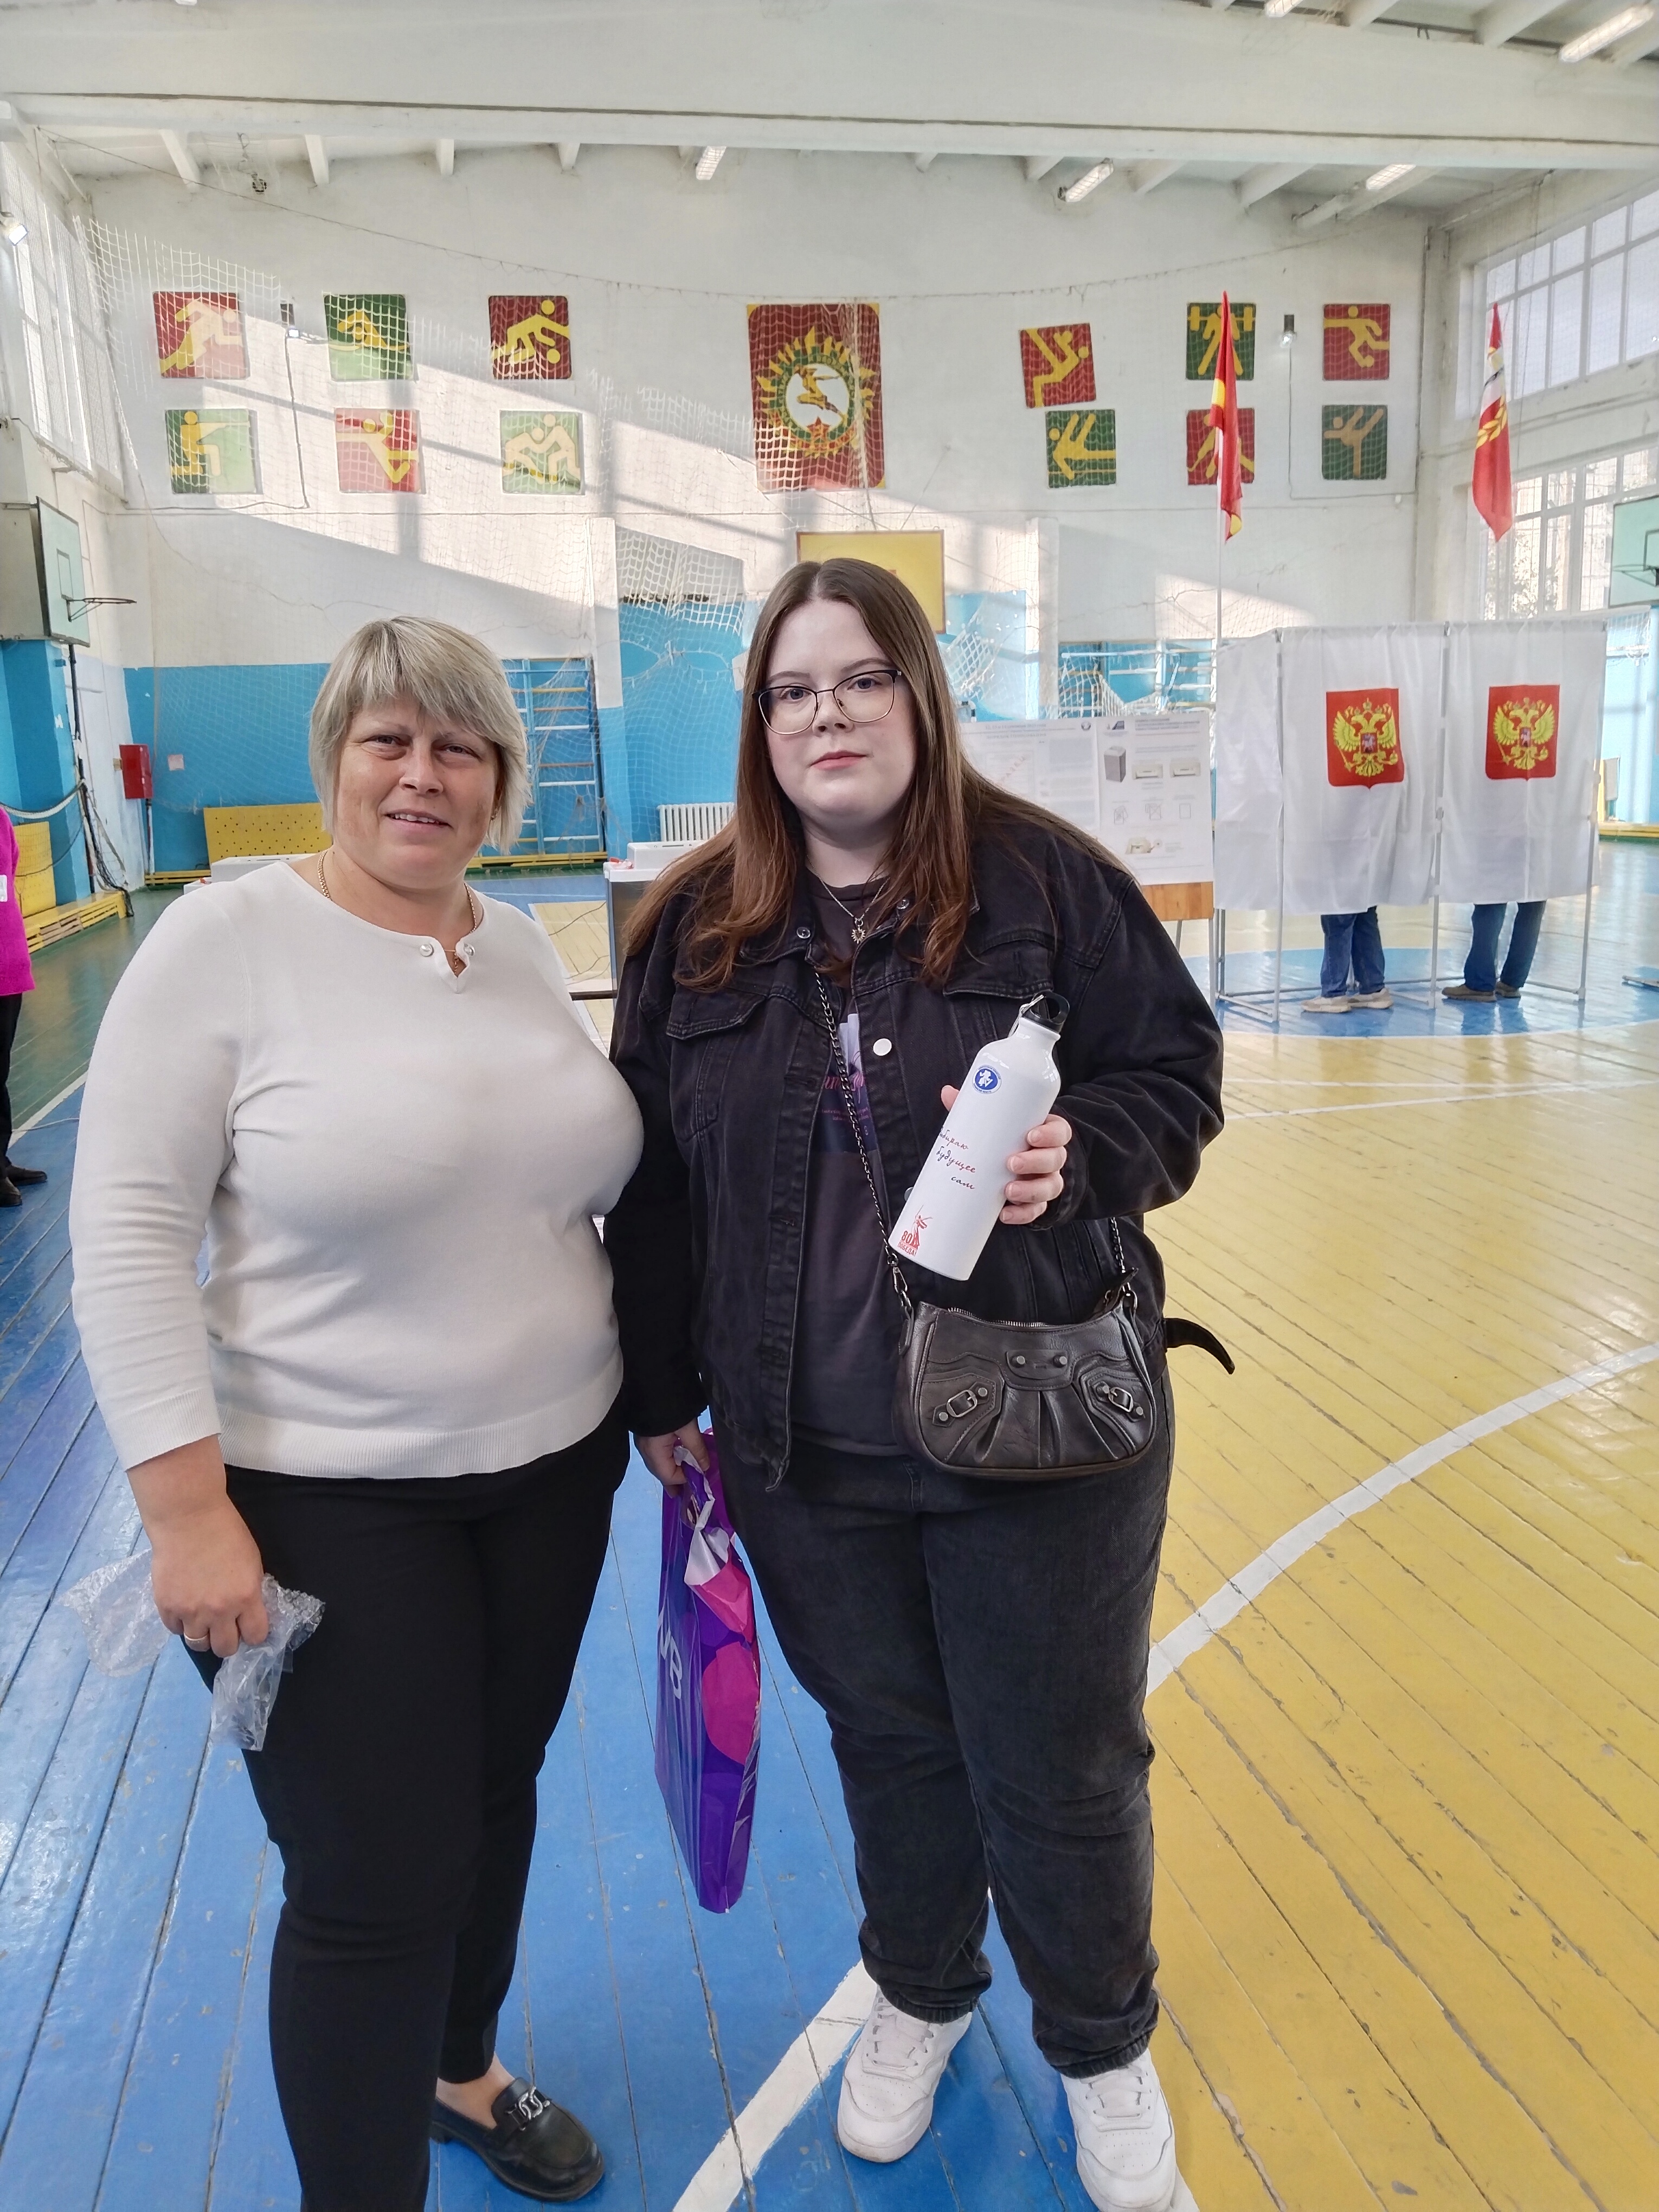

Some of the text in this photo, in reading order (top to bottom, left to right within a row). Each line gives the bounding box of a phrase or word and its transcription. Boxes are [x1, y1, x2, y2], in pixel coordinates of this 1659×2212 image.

[936, 1146, 975, 1173] будущее
[951, 1176, 975, 1189] сам
[901, 1230, 913, 1244] 80
[897, 1242, 917, 1257] ПОБЕДА!
